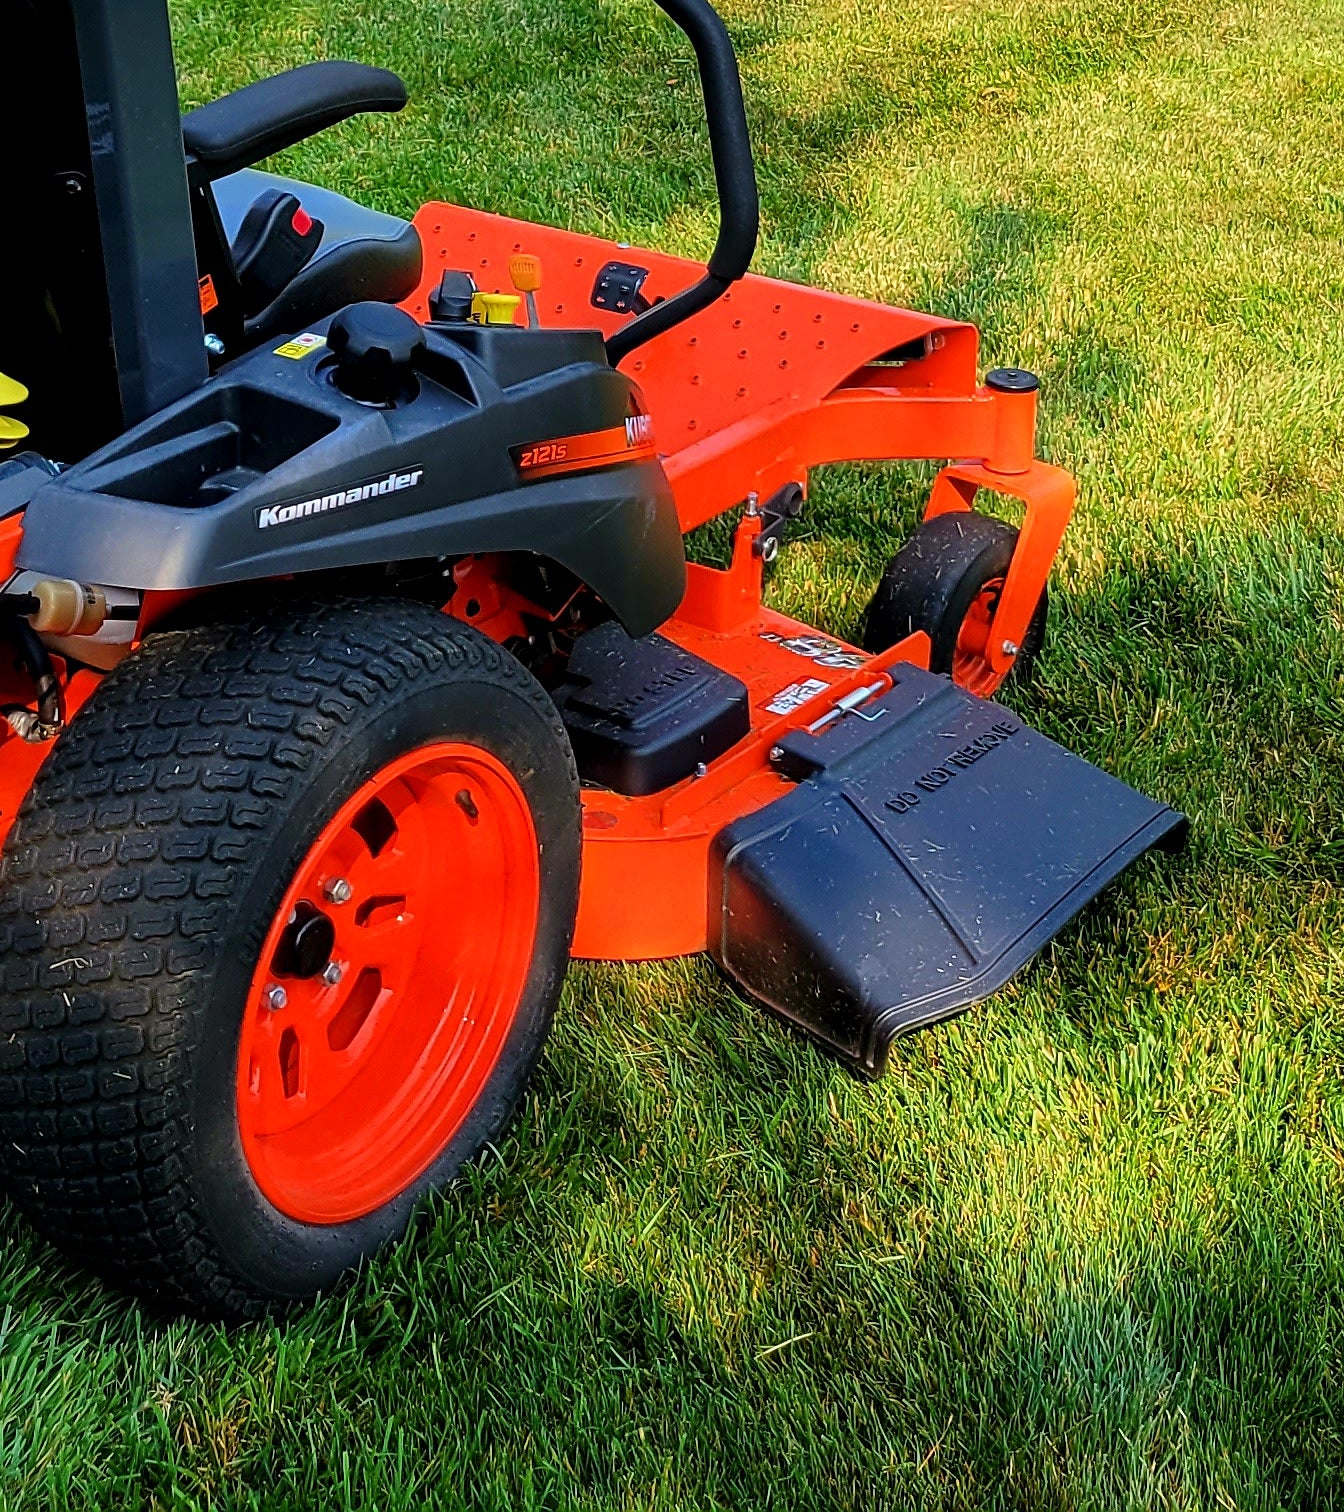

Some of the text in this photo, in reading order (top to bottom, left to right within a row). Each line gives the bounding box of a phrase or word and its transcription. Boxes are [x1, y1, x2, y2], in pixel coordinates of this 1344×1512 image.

[258, 470, 424, 529] Kommander
[884, 721, 1020, 814] DO NOT REMOVE
